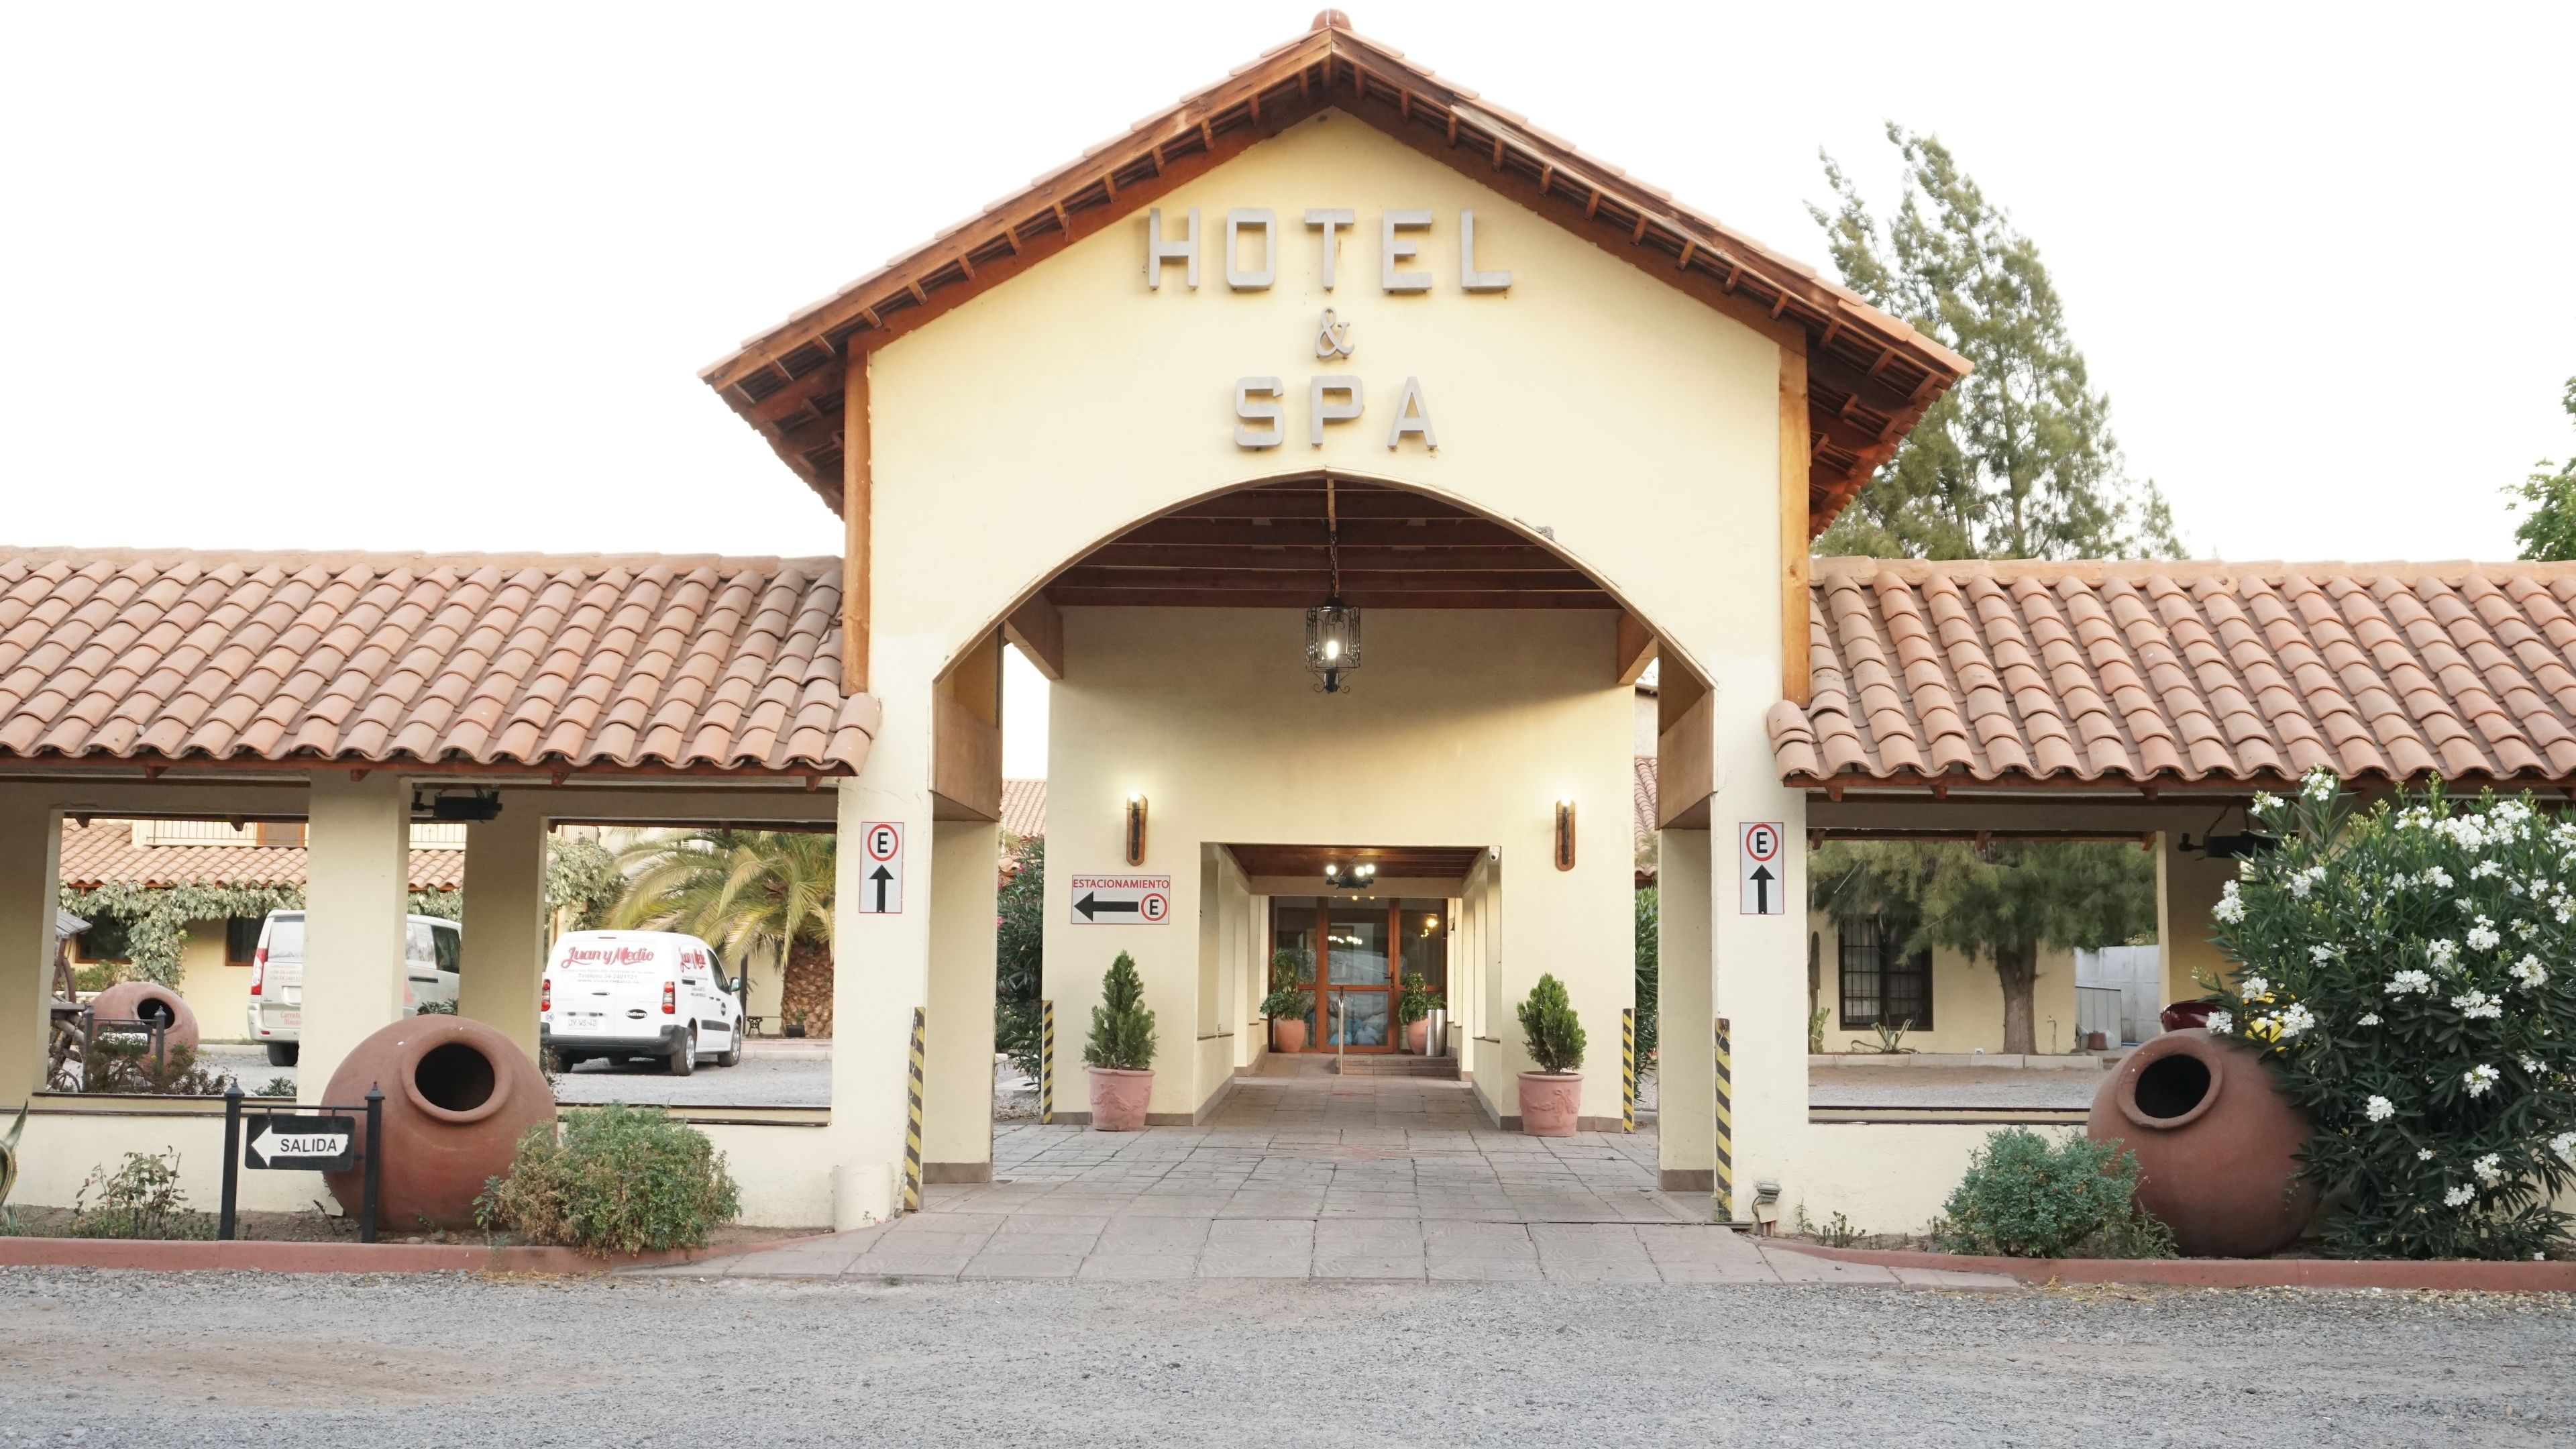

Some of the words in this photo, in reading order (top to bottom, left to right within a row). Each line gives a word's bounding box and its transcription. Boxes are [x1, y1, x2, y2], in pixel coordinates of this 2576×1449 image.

[1148, 207, 1512, 290] HOTEL
[1314, 306, 1355, 359] &
[1234, 375, 1438, 448] SPA
[877, 832, 889, 853] E
[1756, 831, 1768, 853] E
[1073, 879, 1169, 888] ESTACIONAMIENTO
[1149, 899, 1159, 916] E
[560, 947, 600, 969] Juan
[280, 1138, 337, 1152] SALIDA
